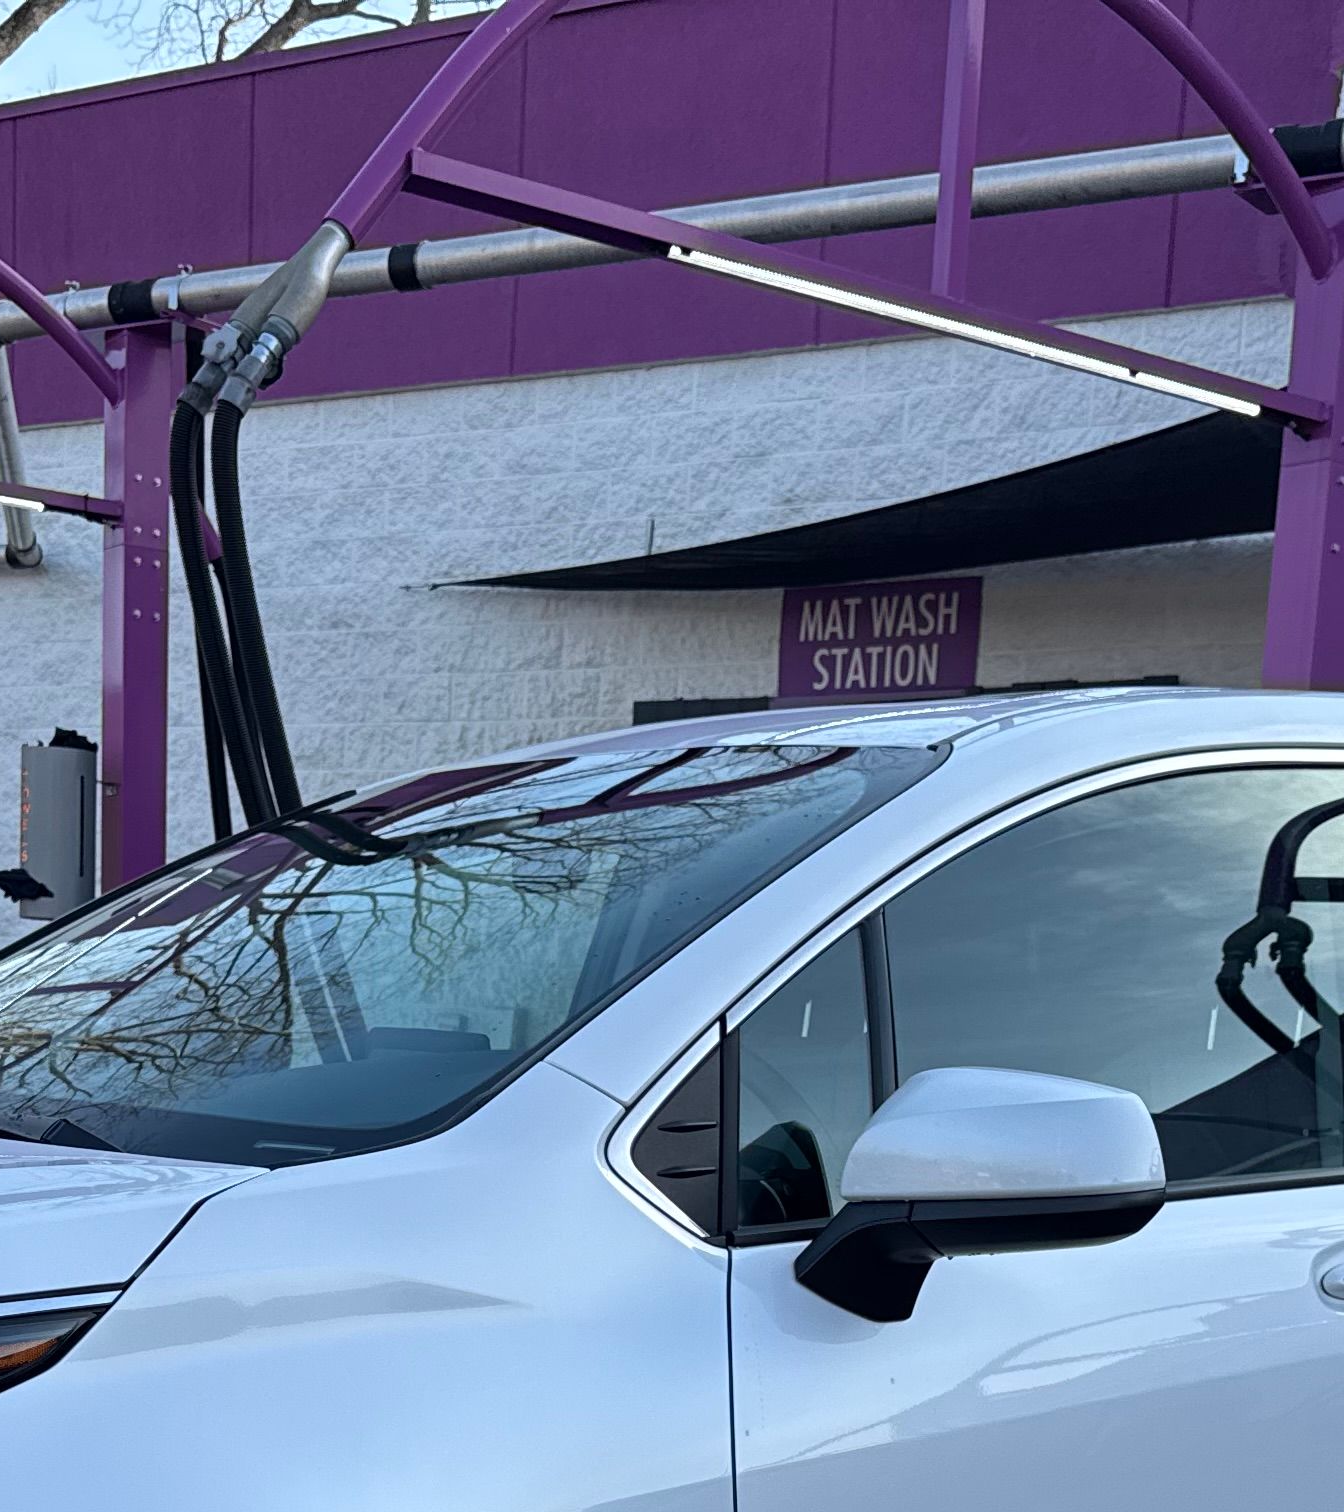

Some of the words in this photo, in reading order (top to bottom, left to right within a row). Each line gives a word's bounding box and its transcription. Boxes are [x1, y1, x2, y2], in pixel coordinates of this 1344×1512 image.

[799, 598, 862, 642] MAT
[870, 592, 959, 638] WASH
[812, 643, 939, 691] STATION
